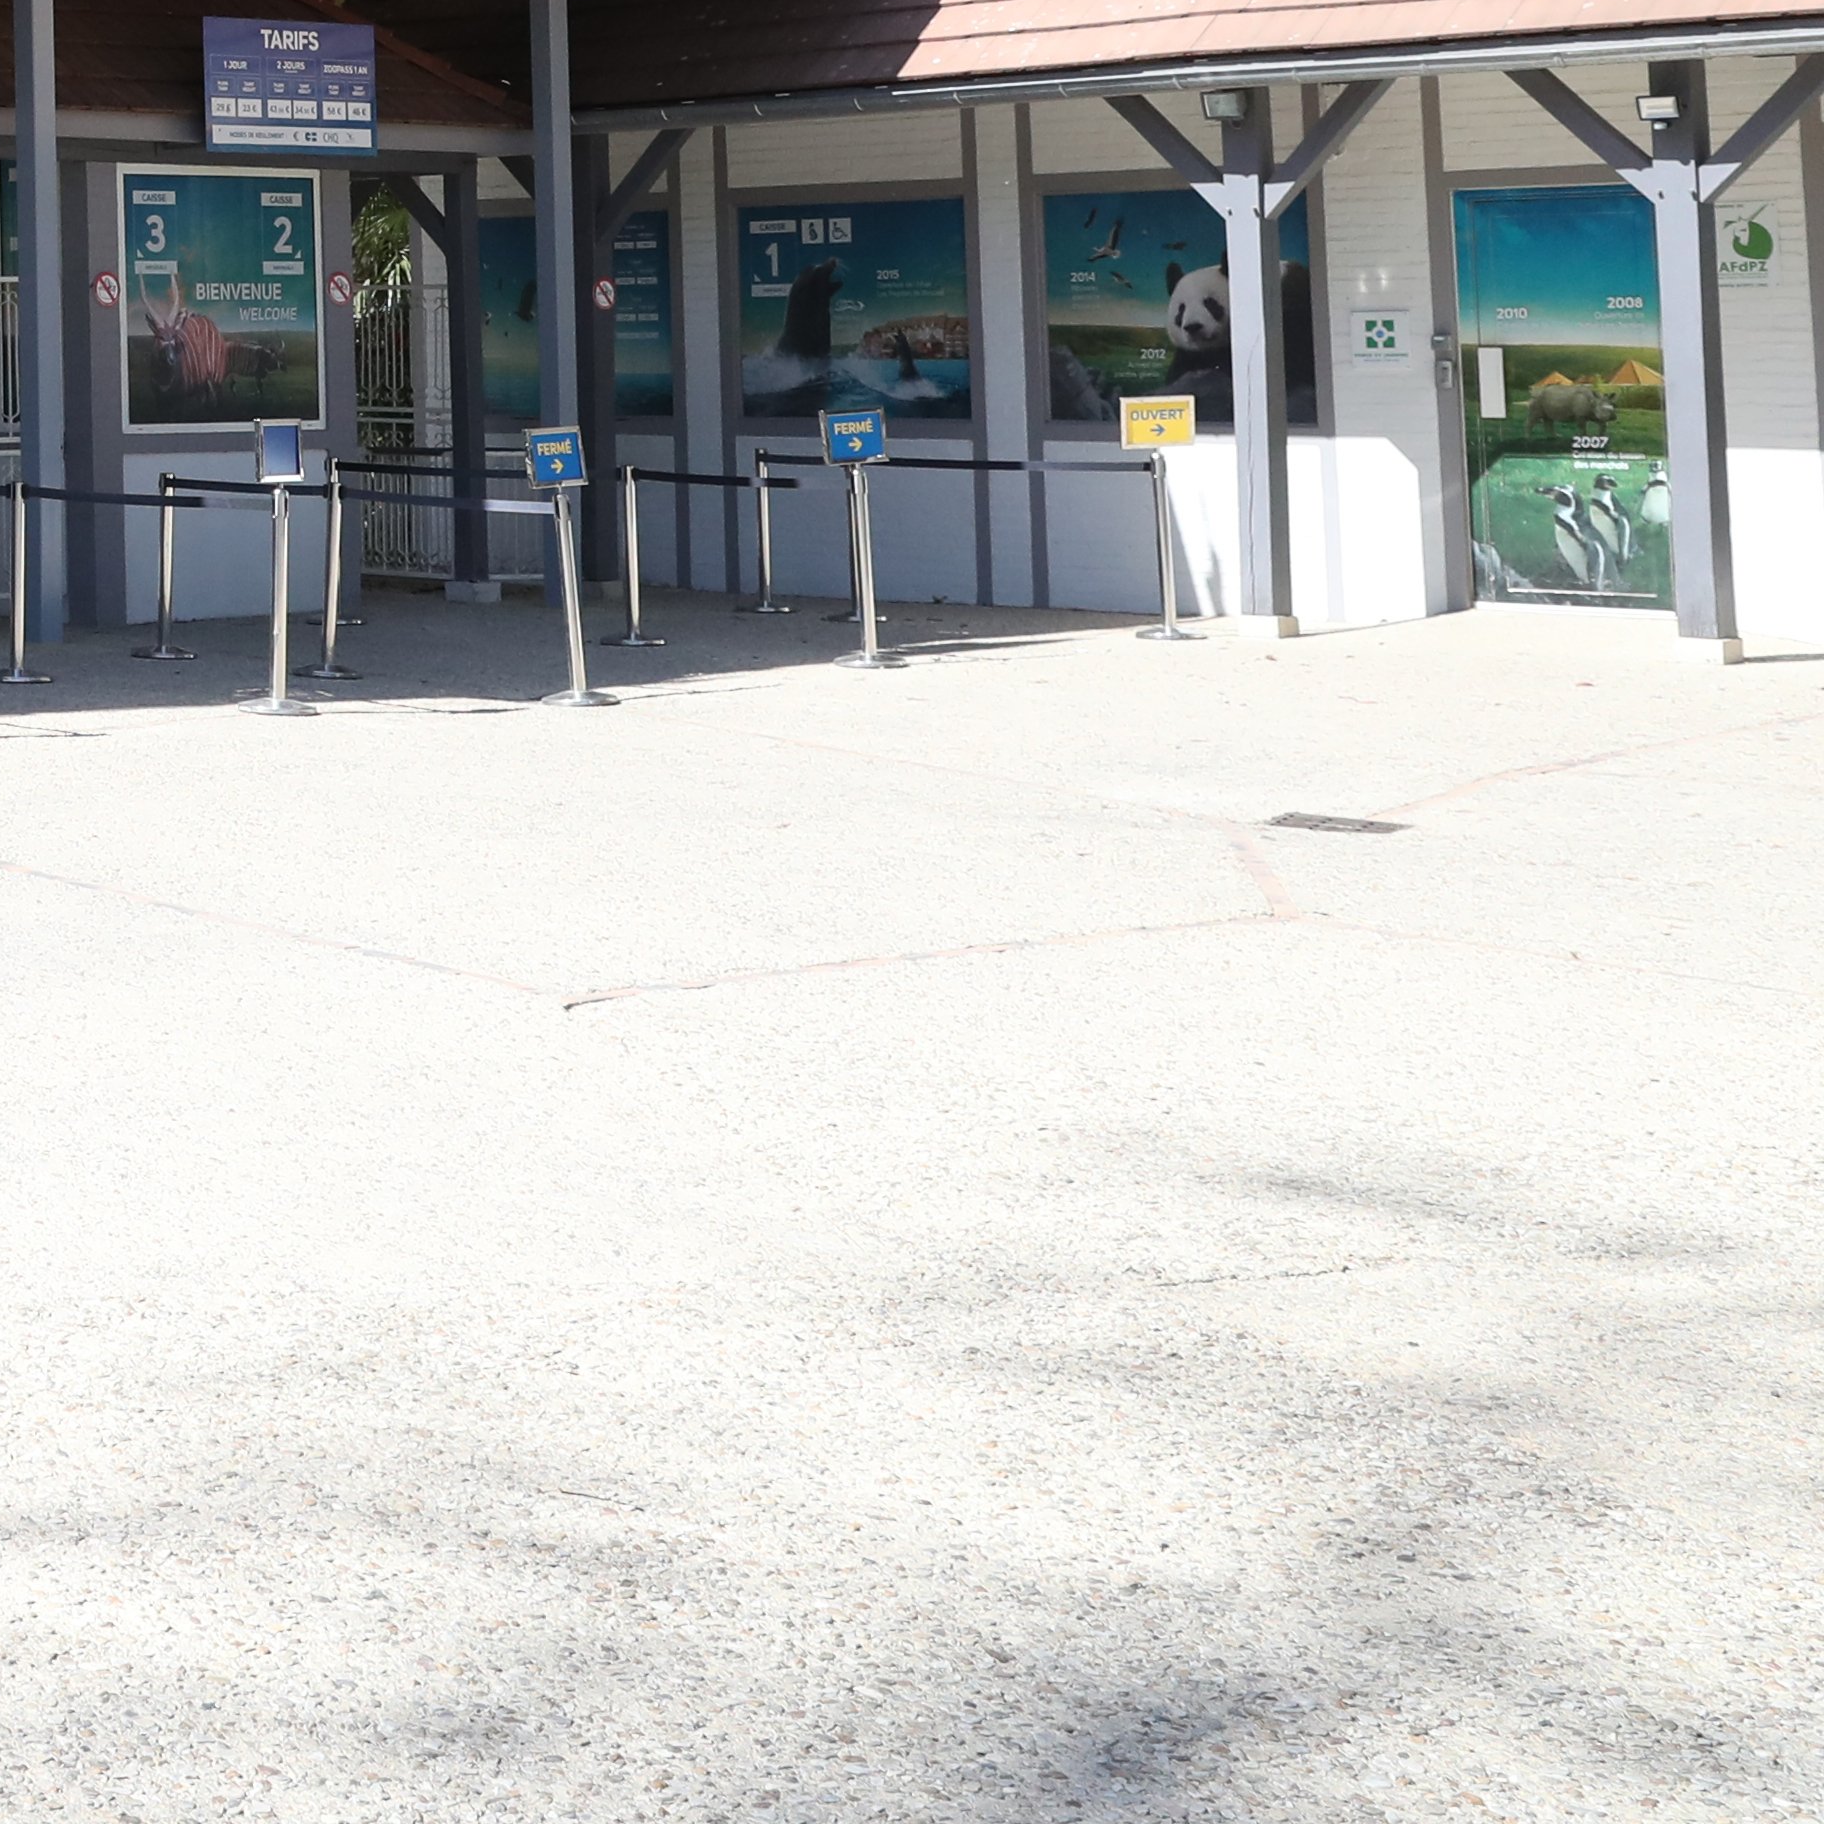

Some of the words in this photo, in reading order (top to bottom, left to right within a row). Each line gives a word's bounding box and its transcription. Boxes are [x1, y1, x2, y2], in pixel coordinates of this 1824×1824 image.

[260, 29, 320, 51] TARIFS
[228, 61, 248, 70] JOUR
[277, 60, 281, 69] 2
[282, 61, 306, 70] JOURS
[141, 193, 167, 203] CAISSE
[269, 195, 293, 205] CAISSE
[759, 222, 785, 232] CAISSE
[144, 214, 166, 253] 3
[273, 216, 293, 254] 2
[765, 242, 779, 277] 1
[1719, 260, 1768, 273] AFdPZ
[876, 269, 900, 280] 2015
[1070, 272, 1096, 282] 2014
[195, 282, 282, 301] BIENVENUE
[1606, 297, 1644, 309] 2008
[239, 306, 298, 321] WELCOME
[1496, 307, 1528, 319] 2010
[1140, 348, 1167, 359] 2012
[1130, 409, 1184, 421] OUVERT
[834, 417, 874, 435] FERMÉ
[537, 438, 572, 456] FERMÉ
[1572, 436, 1609, 448] 2007
